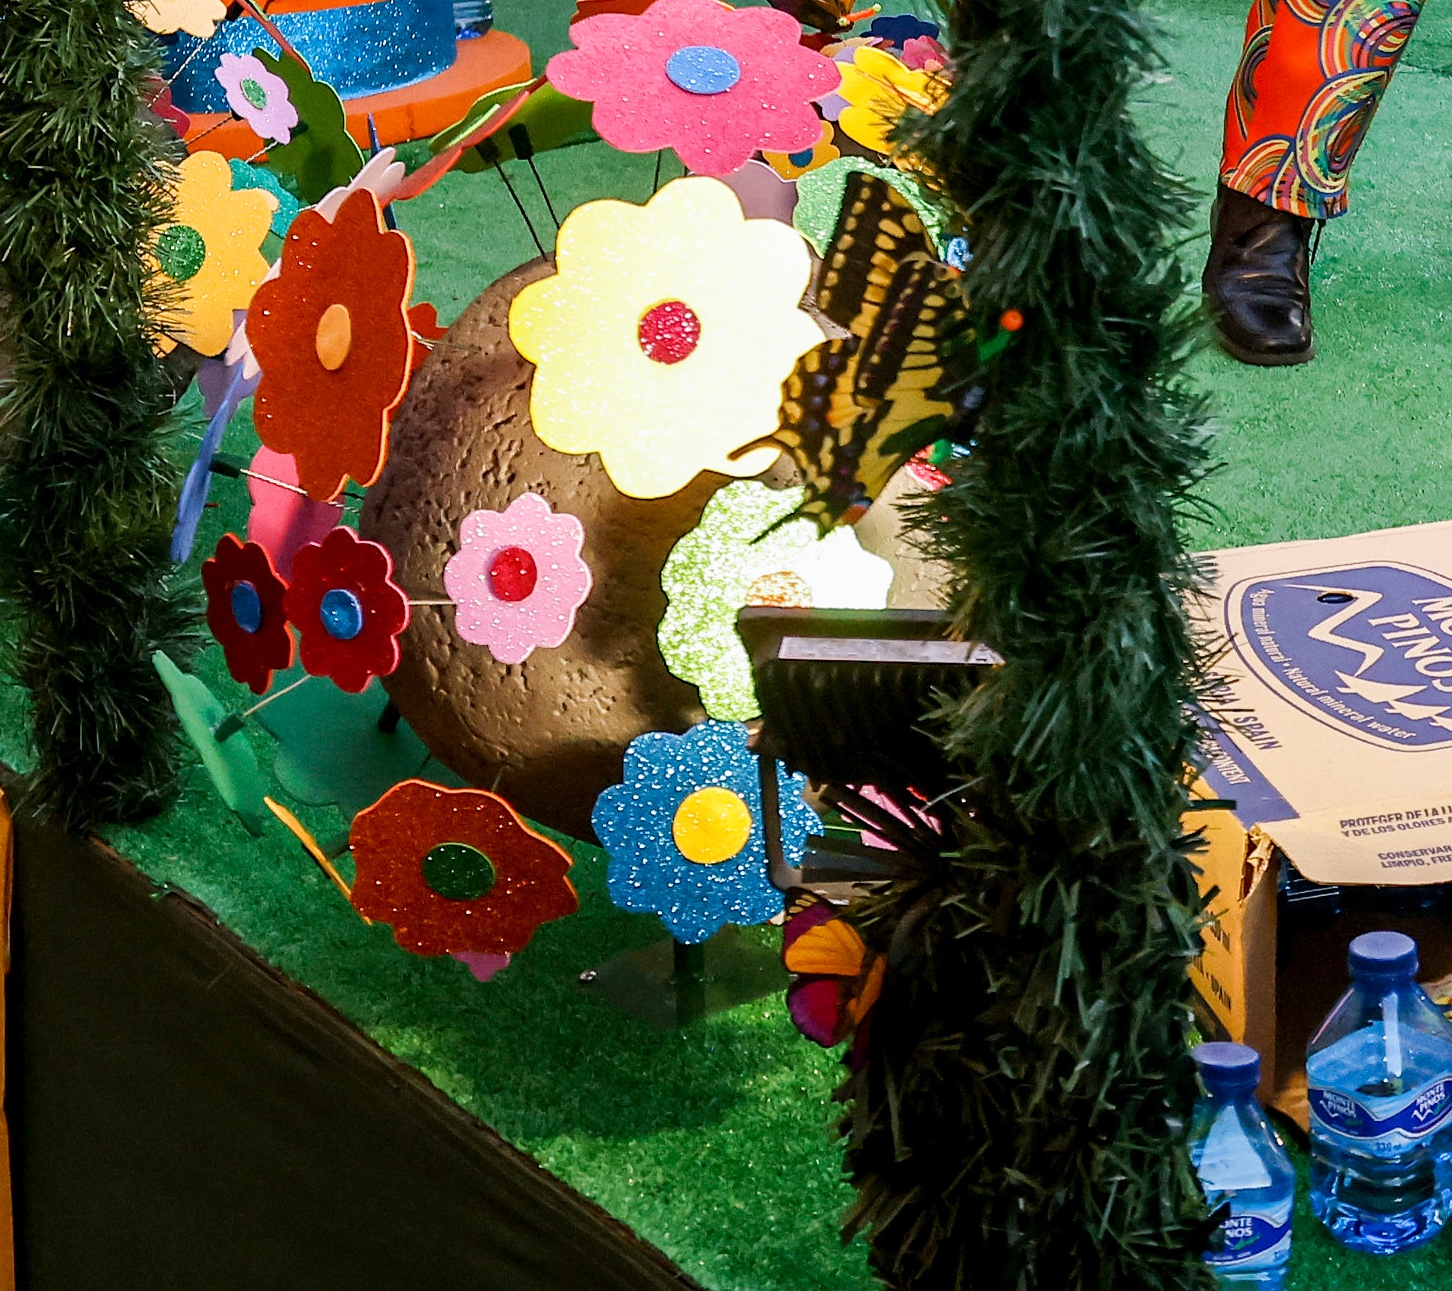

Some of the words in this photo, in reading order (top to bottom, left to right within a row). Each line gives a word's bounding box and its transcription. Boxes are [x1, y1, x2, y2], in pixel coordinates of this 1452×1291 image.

[1251, 607, 1276, 635] mineral
[1258, 635, 1292, 663] natural
[1282, 667, 1329, 696] Natural
[1316, 694, 1375, 723] mineral
[1233, 716, 1284, 750] SPAIN
[1366, 721, 1417, 739] water
[1339, 813, 1403, 829] PROTEGER
[1352, 827, 1370, 837] DE
[1371, 825, 1396, 835] LOS
[1397, 818, 1446, 831] OLORES
[1377, 845, 1452, 860] CONSERVAR
[1380, 858, 1431, 869] LIMPIO,
[1219, 1217, 1253, 1228] ONTE
[1225, 1227, 1253, 1238] NOS
